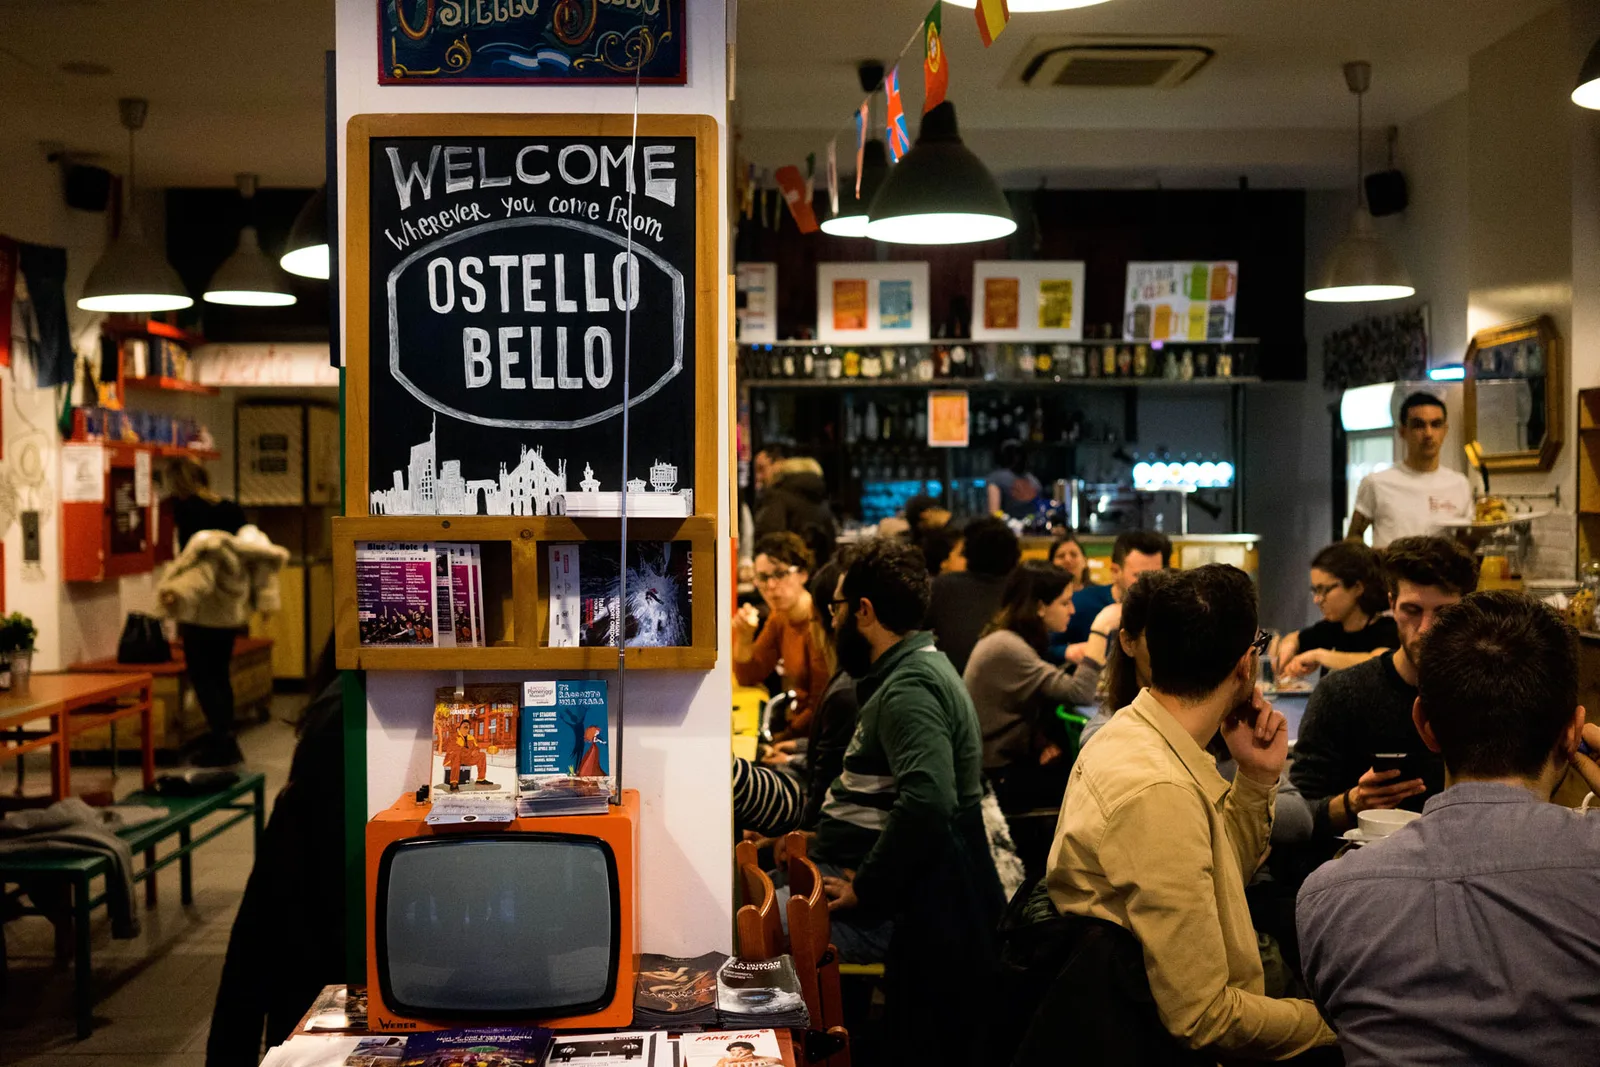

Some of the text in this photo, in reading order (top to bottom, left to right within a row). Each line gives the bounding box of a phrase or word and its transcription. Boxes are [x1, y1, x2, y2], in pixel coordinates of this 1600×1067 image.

[385, 144, 677, 211] WELCOME
[501, 196, 535, 216] you
[549, 197, 600, 221] come
[427, 252, 640, 314] OSTELLO
[463, 326, 613, 389] BELLO
[378, 1017, 417, 1030] WEBER
